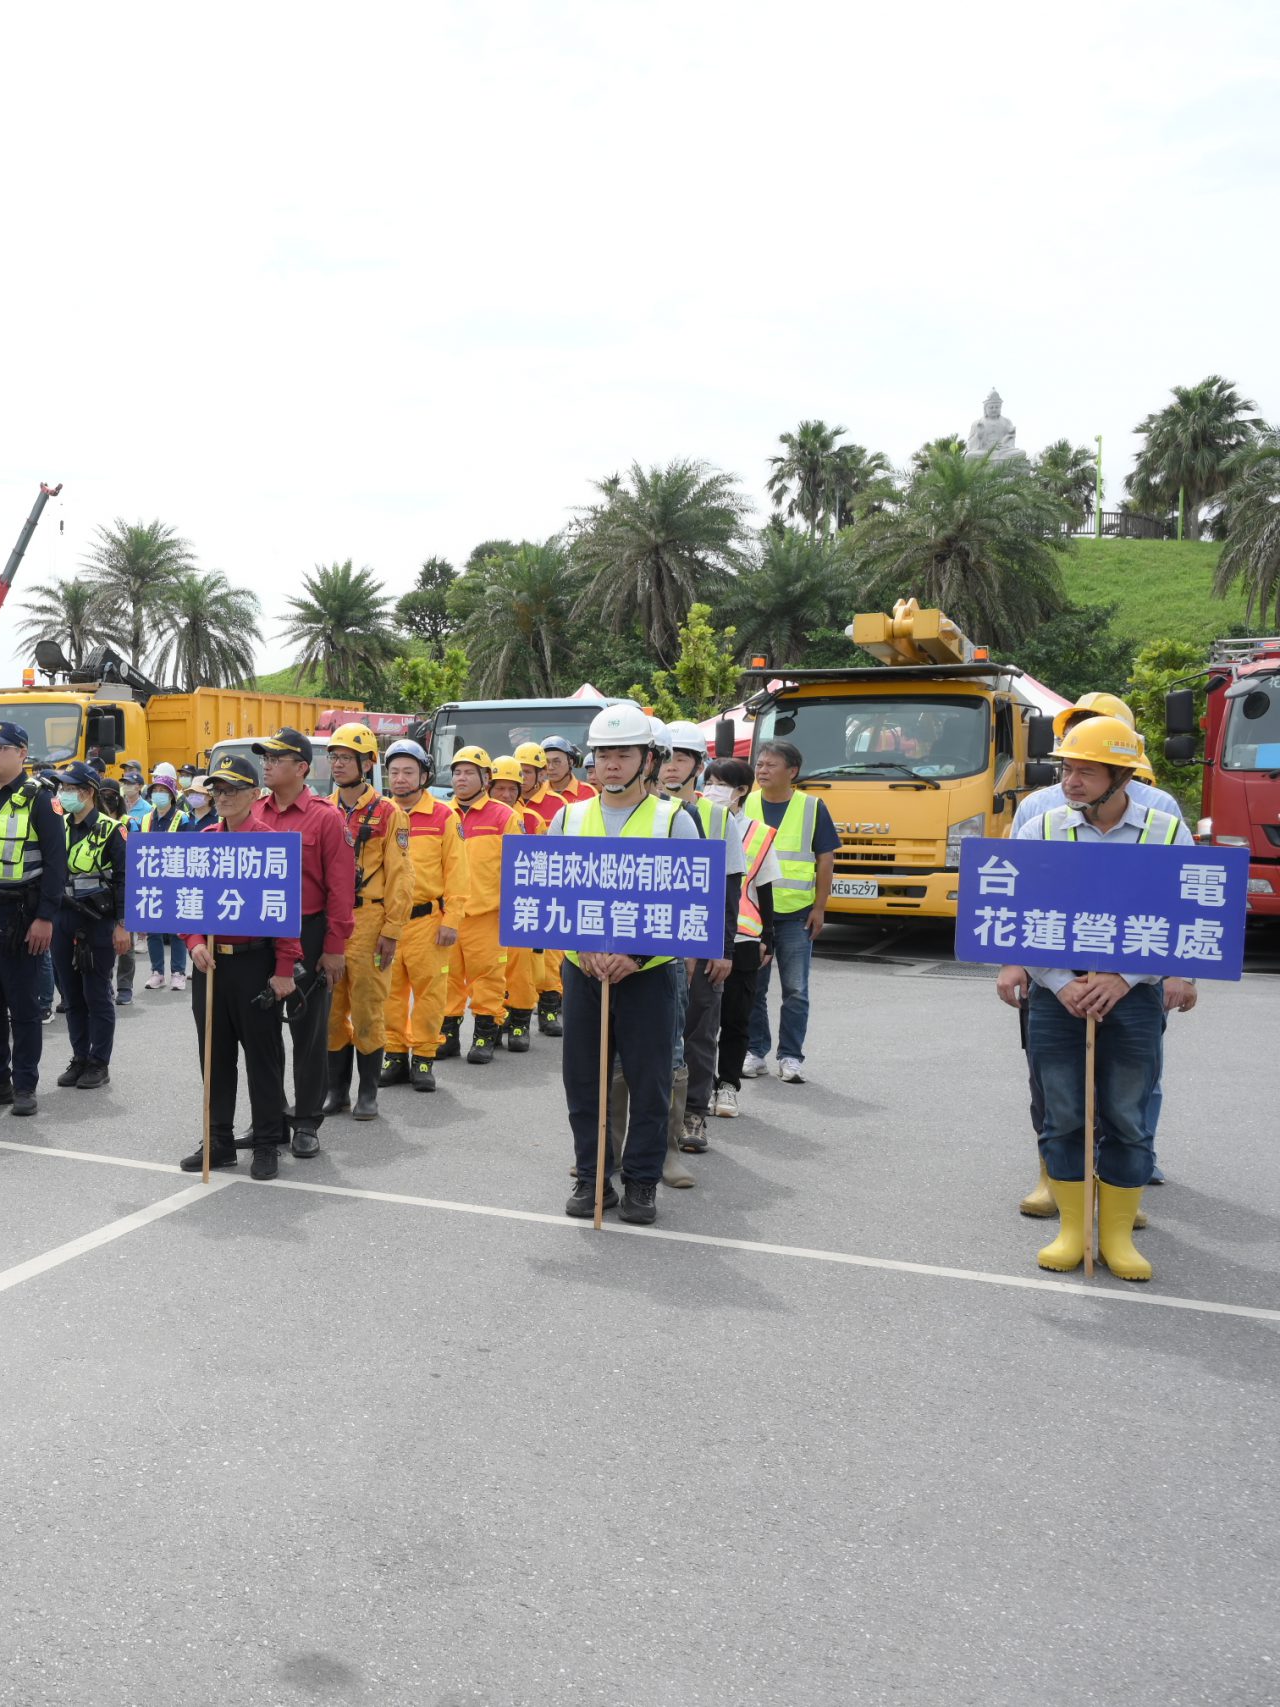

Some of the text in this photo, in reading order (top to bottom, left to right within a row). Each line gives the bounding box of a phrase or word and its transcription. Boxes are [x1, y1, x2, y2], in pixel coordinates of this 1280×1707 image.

[832, 822, 890, 834] SUZU
[136, 845, 288, 880] 花蓮縣消防局
[513, 850, 711, 893] 台灣自來水股份有限公司
[135, 886, 287, 922] 花蓮分局
[831, 883, 877, 895] KEQ-5297
[512, 896, 709, 942] 第九區管理處
[973, 906, 1225, 961] 花蓮營業處
